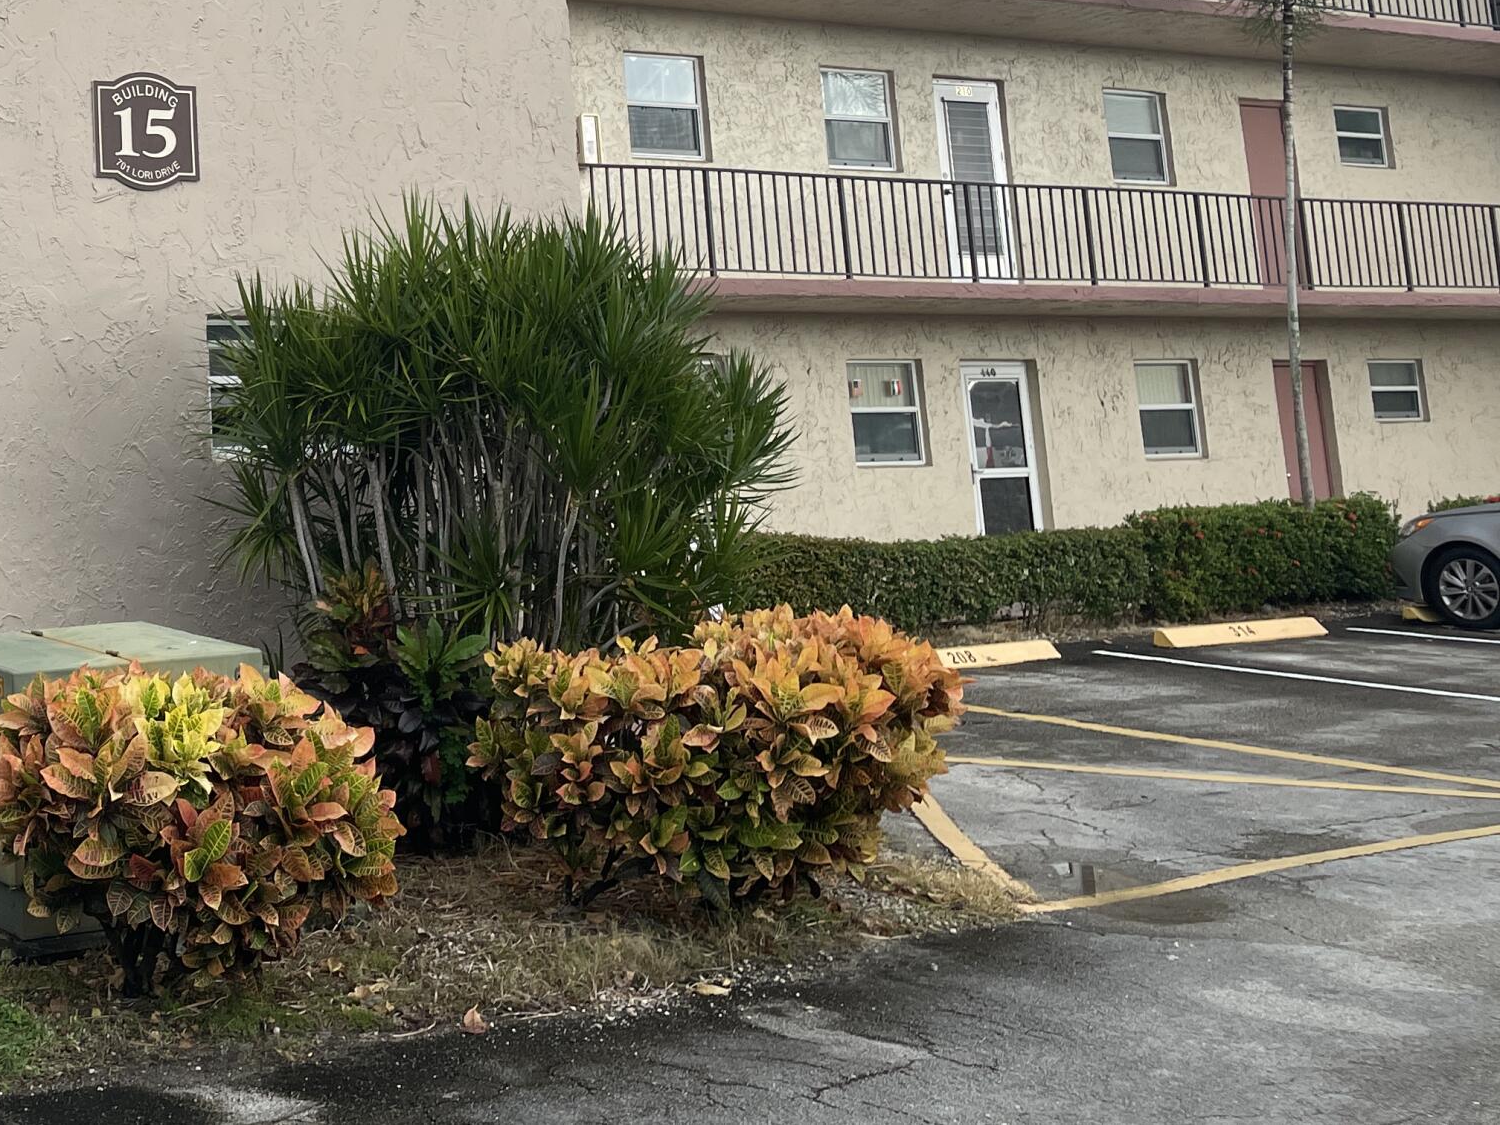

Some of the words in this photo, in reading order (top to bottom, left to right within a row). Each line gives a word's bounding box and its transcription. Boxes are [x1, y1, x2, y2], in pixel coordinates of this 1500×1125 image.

[112, 84, 178, 108] BUILDING
[113, 107, 177, 158] 15
[116, 158, 131, 173] 701
[131, 168, 154, 179] LORI
[155, 160, 181, 179] DRIVE
[946, 650, 977, 664] 208
